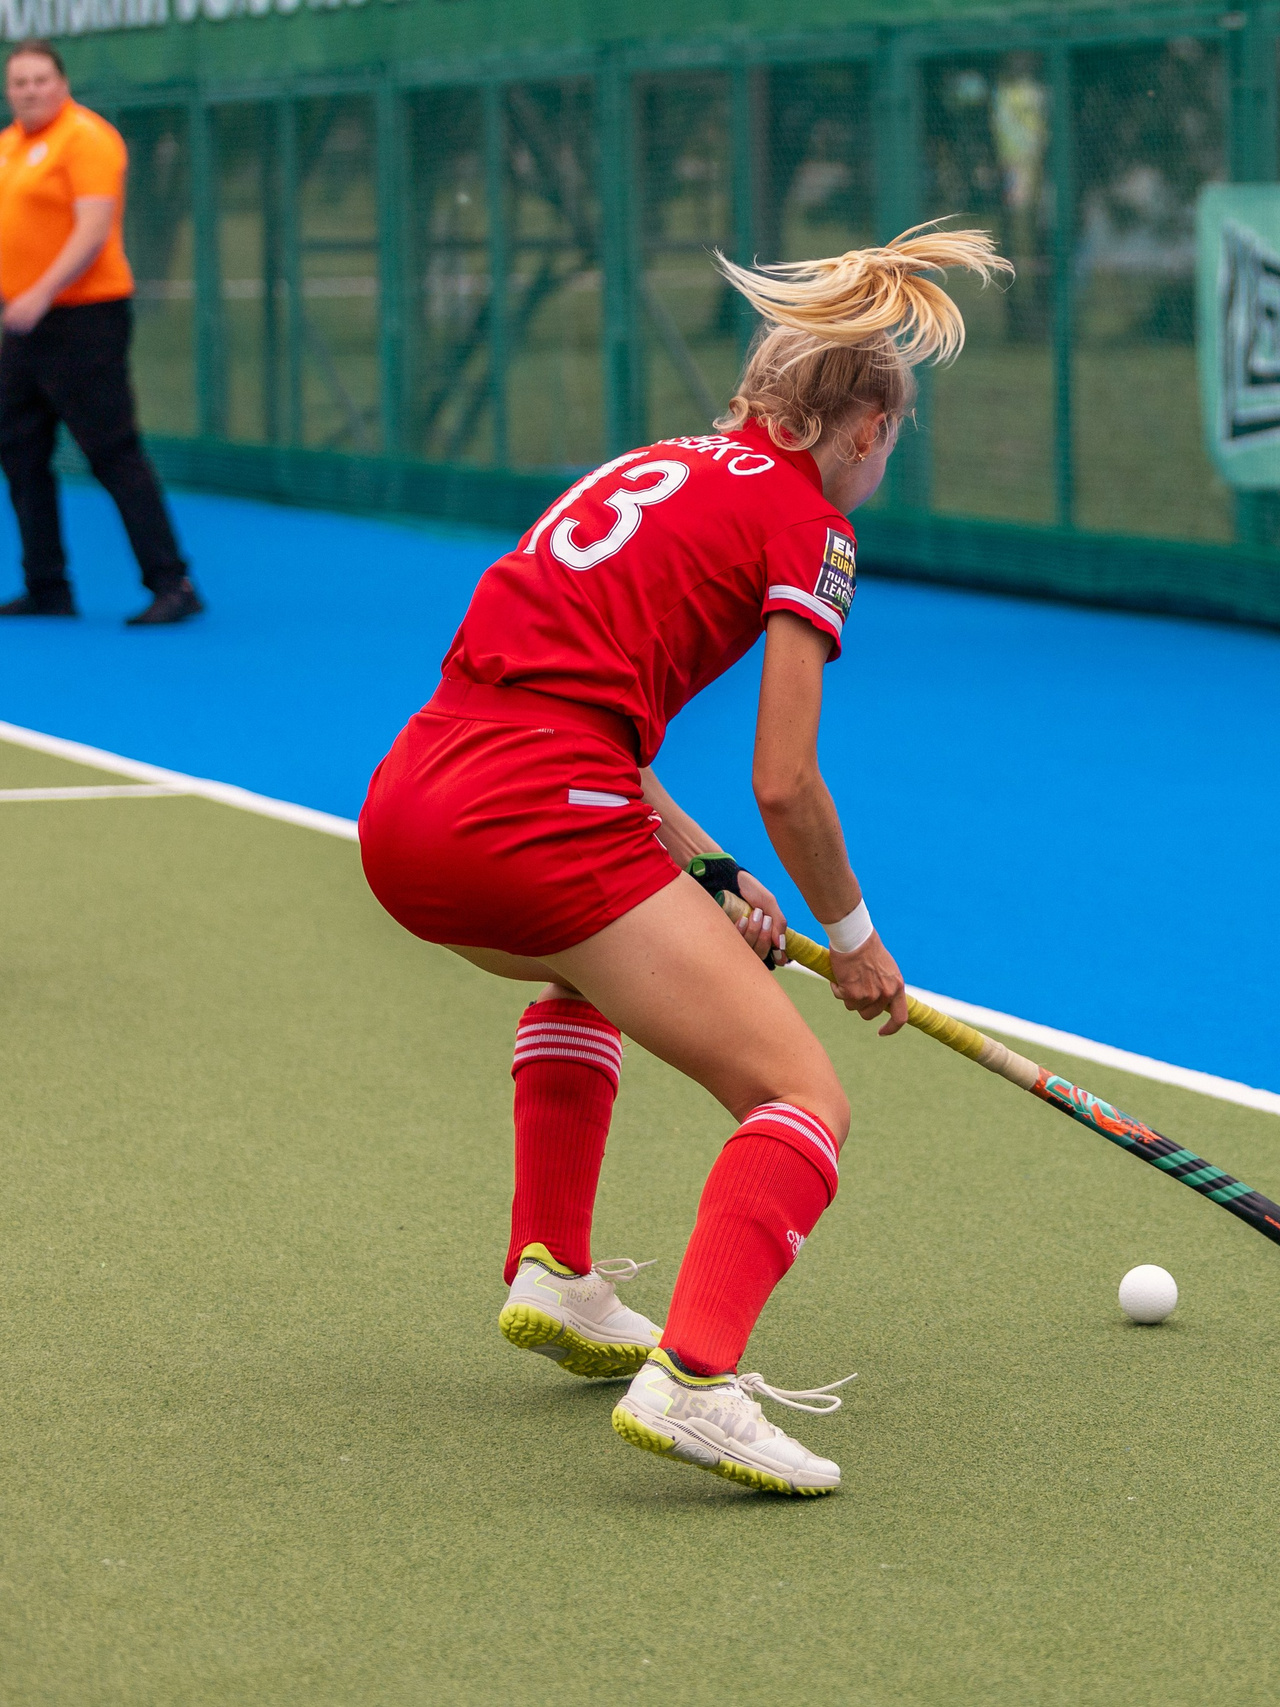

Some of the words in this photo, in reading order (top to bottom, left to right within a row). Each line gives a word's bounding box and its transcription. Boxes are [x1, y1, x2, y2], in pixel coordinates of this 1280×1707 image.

[523, 451, 691, 572] 13
[830, 552, 854, 578] EURO
[667, 1387, 758, 1444] OSAKA
